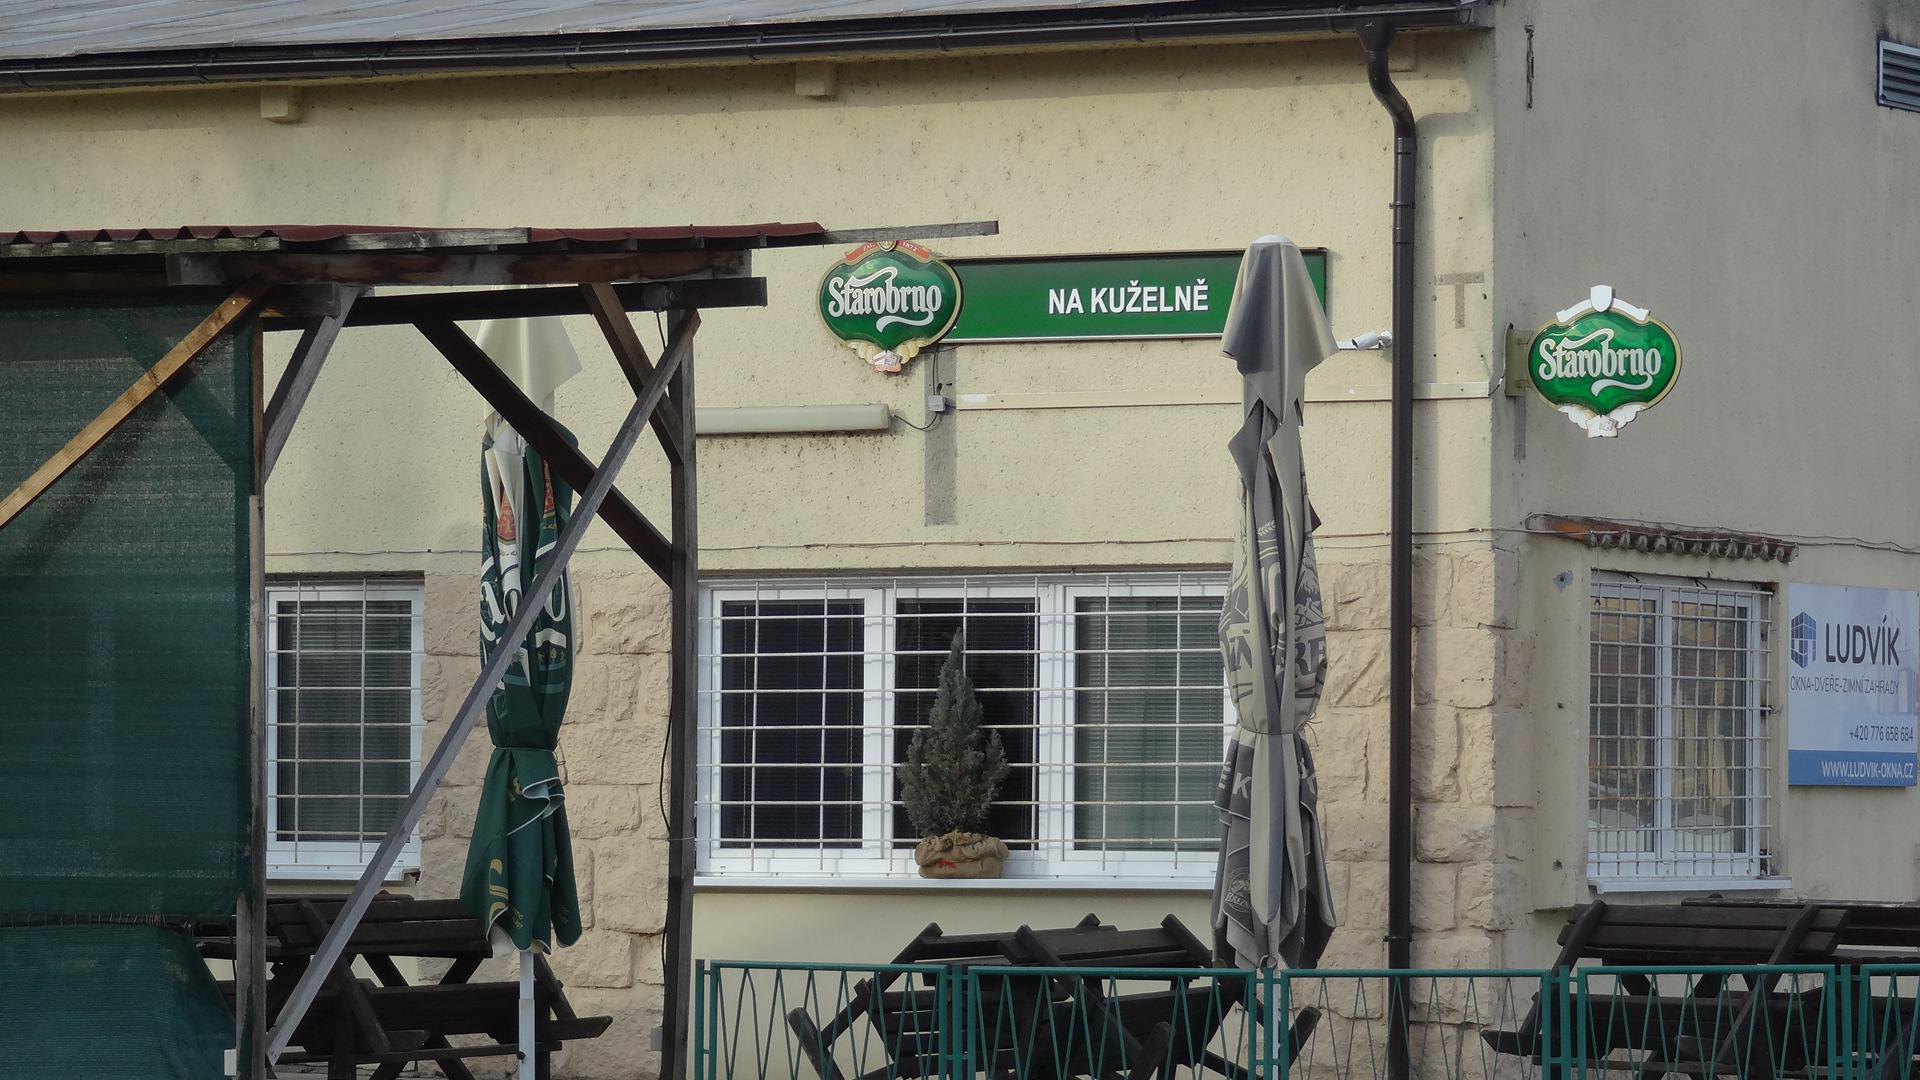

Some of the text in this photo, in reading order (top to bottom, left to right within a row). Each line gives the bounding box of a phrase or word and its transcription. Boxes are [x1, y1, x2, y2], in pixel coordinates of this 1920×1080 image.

[828, 266, 942, 333] Starobrno
[1048, 279, 1209, 315] NA KUŽELNĚ
[1538, 328, 1662, 397] Starobrno
[1825, 615, 1900, 666] LUDVÍK
[1865, 678, 1899, 695] ZAHRADY
[1849, 725, 1914, 742] +420 776 658 684
[1821, 761, 1914, 778] WWW.LUDVIK-OKNA.CZ
